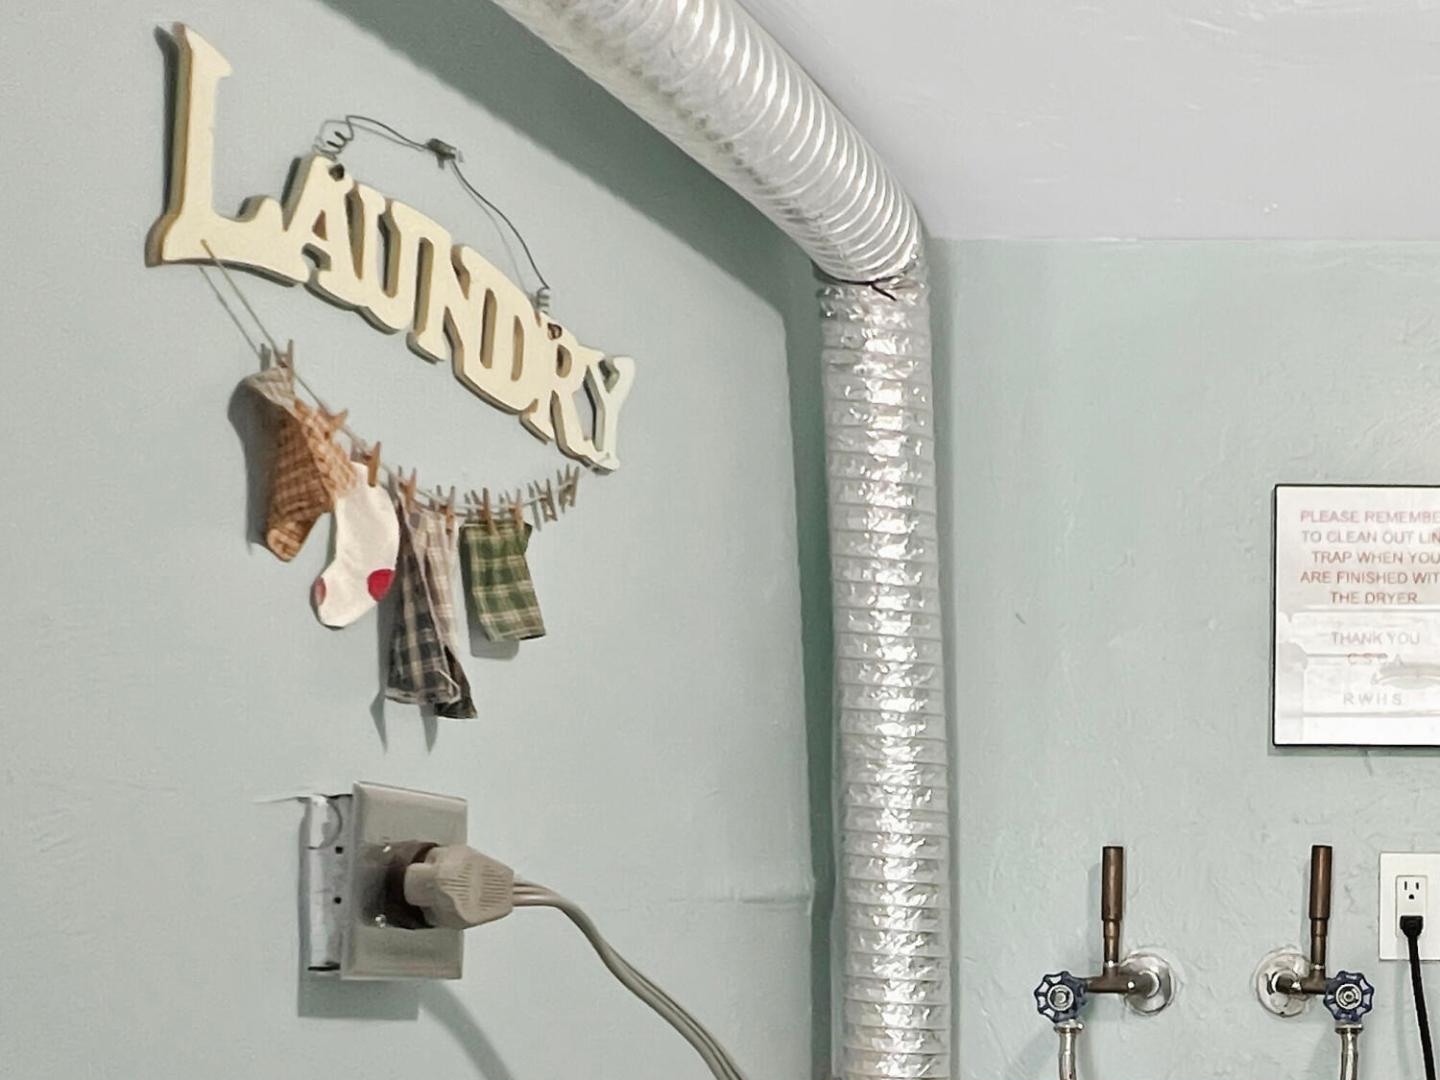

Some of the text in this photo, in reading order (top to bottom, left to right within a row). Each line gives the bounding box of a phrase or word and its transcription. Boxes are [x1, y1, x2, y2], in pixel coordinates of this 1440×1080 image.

[148, 22, 635, 472] LAUNDRY
[1300, 509, 1360, 524] PLEASE
[1301, 529, 1324, 544] TO
[1325, 529, 1378, 544] CLEAN
[1380, 529, 1415, 545] OUT
[1311, 550, 1440, 565] TRAP WHEN YOU
[1300, 569, 1332, 584] ARE
[1335, 569, 1409, 585] FINISHED
[1330, 590, 1417, 605] THE DRYER
[1331, 630, 1420, 646] THANK YOU
